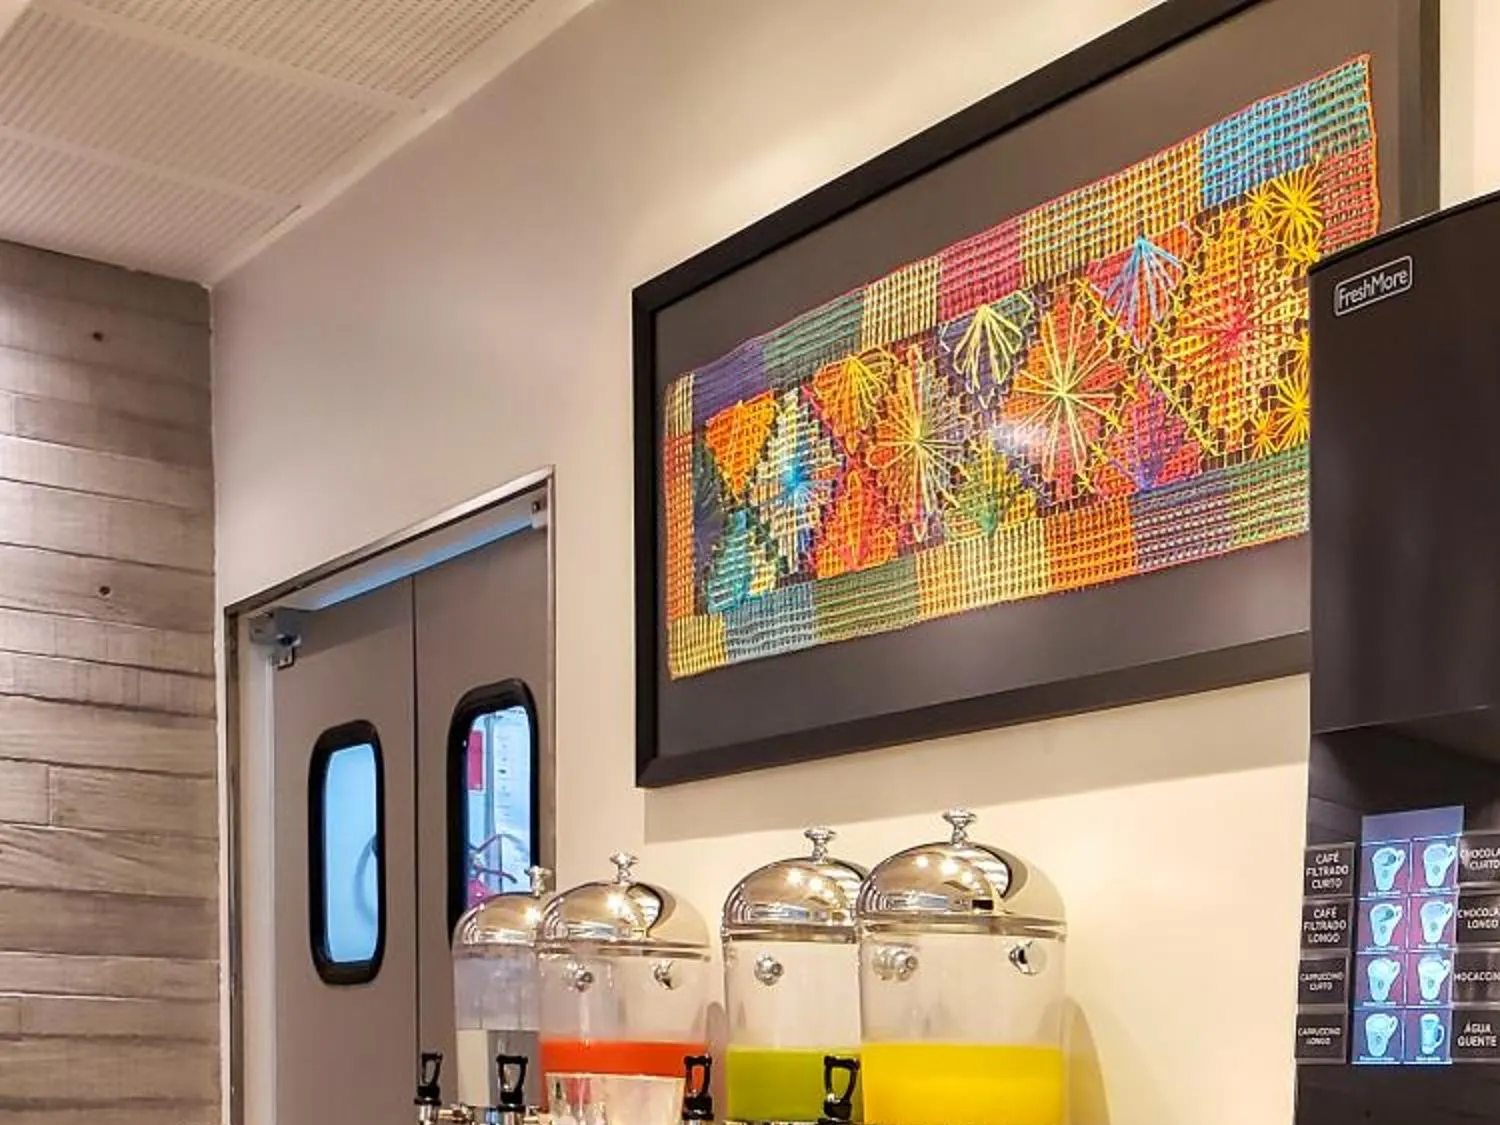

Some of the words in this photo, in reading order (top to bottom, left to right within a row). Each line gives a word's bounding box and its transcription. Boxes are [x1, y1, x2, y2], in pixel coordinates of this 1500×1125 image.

[1339, 269, 1408, 309] FreshMore
[1315, 850, 1339, 865] CAFÉ
[1306, 864, 1349, 877] FILTRADO
[1313, 905, 1337, 919] CAFÉ
[1467, 919, 1499, 929] LONGO
[1463, 1020, 1492, 1035] ÁGUA
[1457, 1035, 1497, 1048] QUENTE
